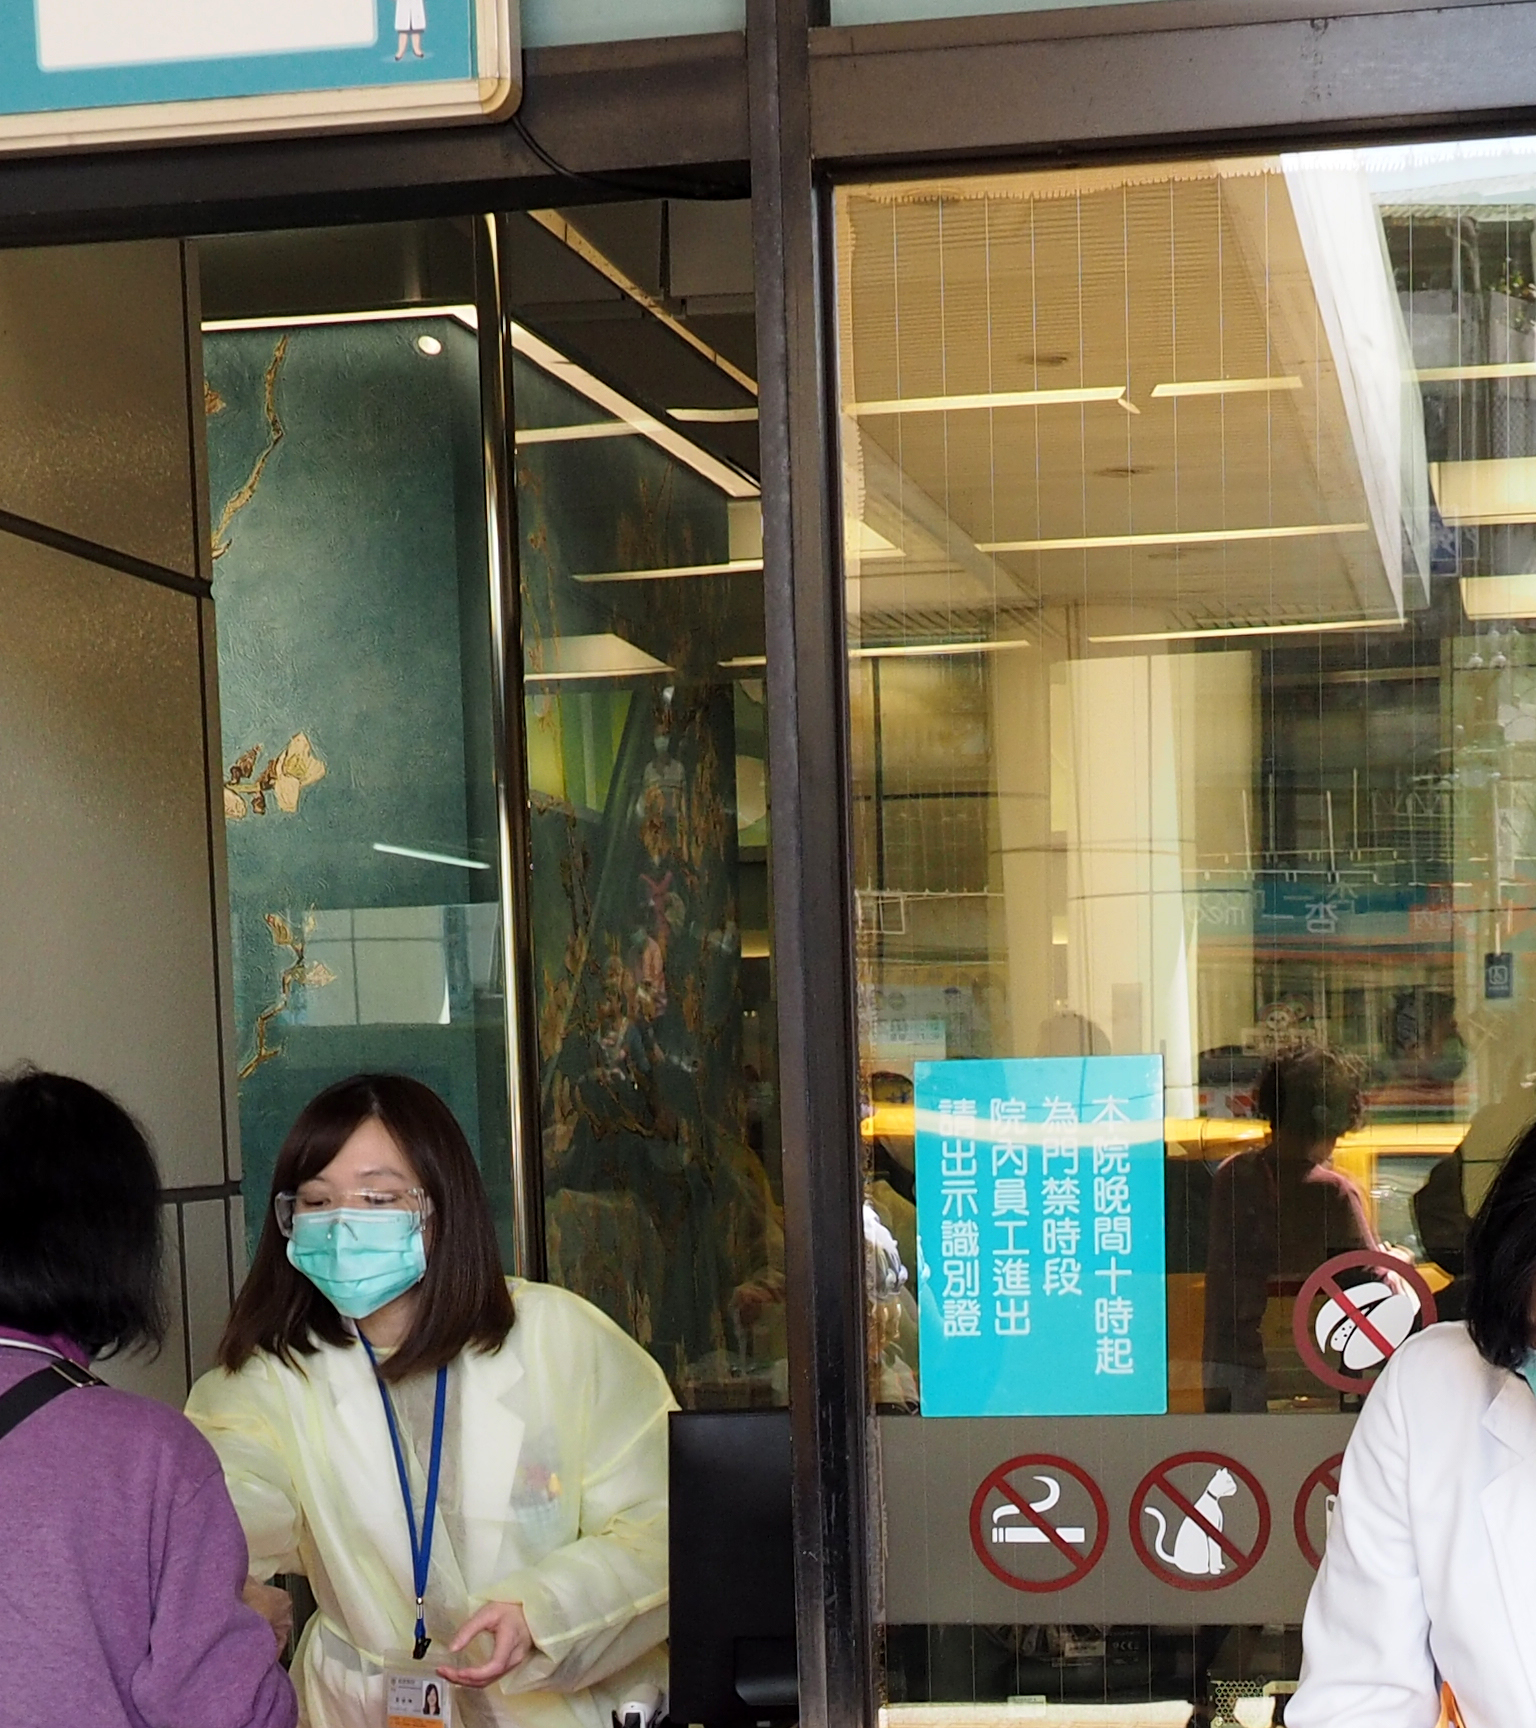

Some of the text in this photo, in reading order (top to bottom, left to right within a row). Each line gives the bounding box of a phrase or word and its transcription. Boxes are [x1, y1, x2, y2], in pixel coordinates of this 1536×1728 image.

[938, 1098, 982, 1337] 請出示識別證
[990, 1098, 1031, 1336] 院內員工進出
[1041, 1096, 1082, 1296] 為門禁時段
[1091, 1096, 1134, 1375] 本院晚間十時起
